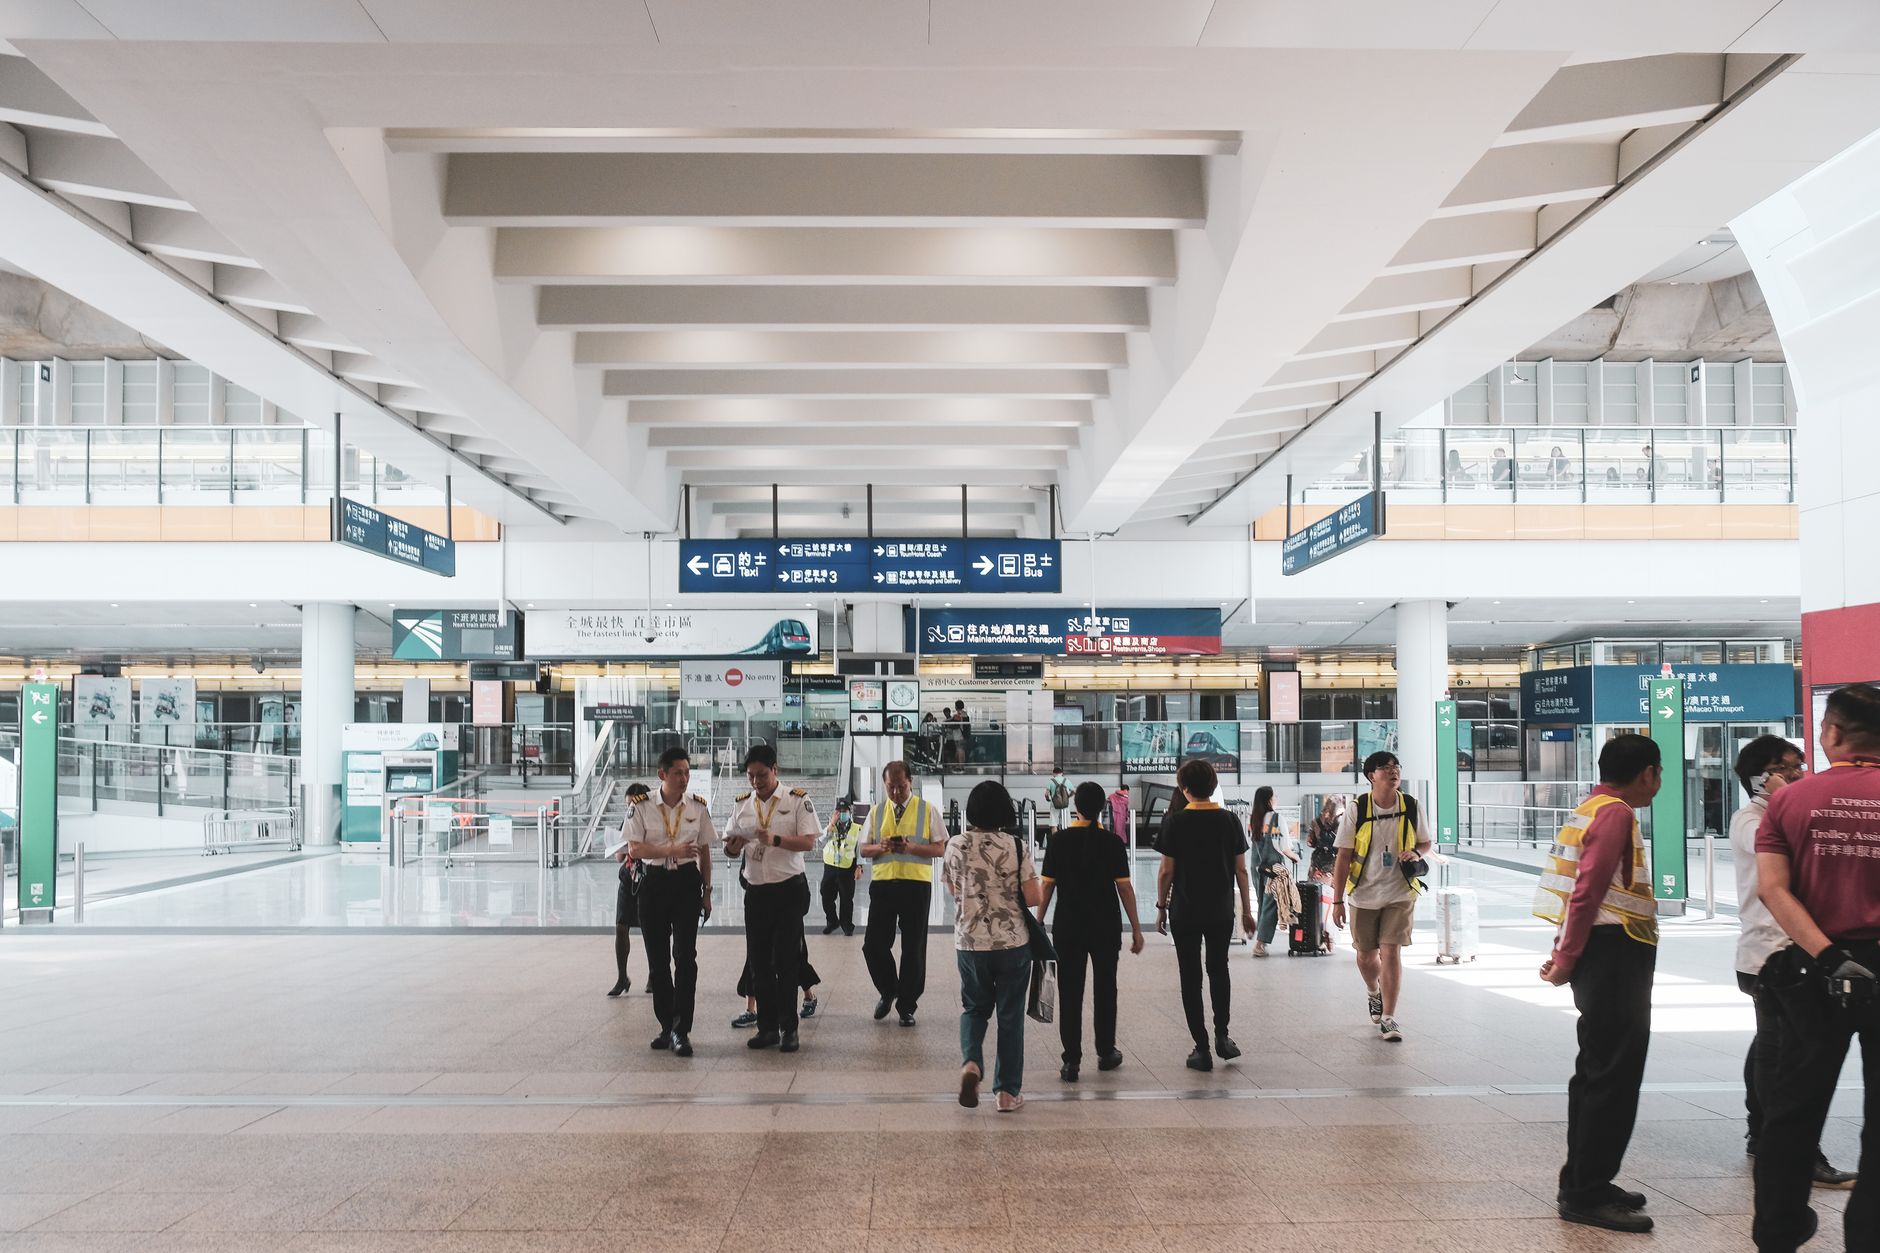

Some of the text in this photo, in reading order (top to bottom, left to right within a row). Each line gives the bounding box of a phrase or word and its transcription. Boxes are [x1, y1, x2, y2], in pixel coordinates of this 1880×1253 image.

[738, 552, 767, 567] 的士
[1023, 553, 1053, 567] 巴士
[739, 567, 759, 577] Taxi
[829, 571, 837, 583] 3
[1023, 567, 1043, 577] Bus
[567, 616, 624, 629] 全城最快
[664, 630, 680, 638] city
[967, 635, 1063, 645] Mainland/Macao Transport
[685, 673, 723, 682] 不准進入
[745, 673, 777, 682] No entry
[1713, 705, 1744, 713] Transport
[1810, 829, 1850, 841] Trolley
